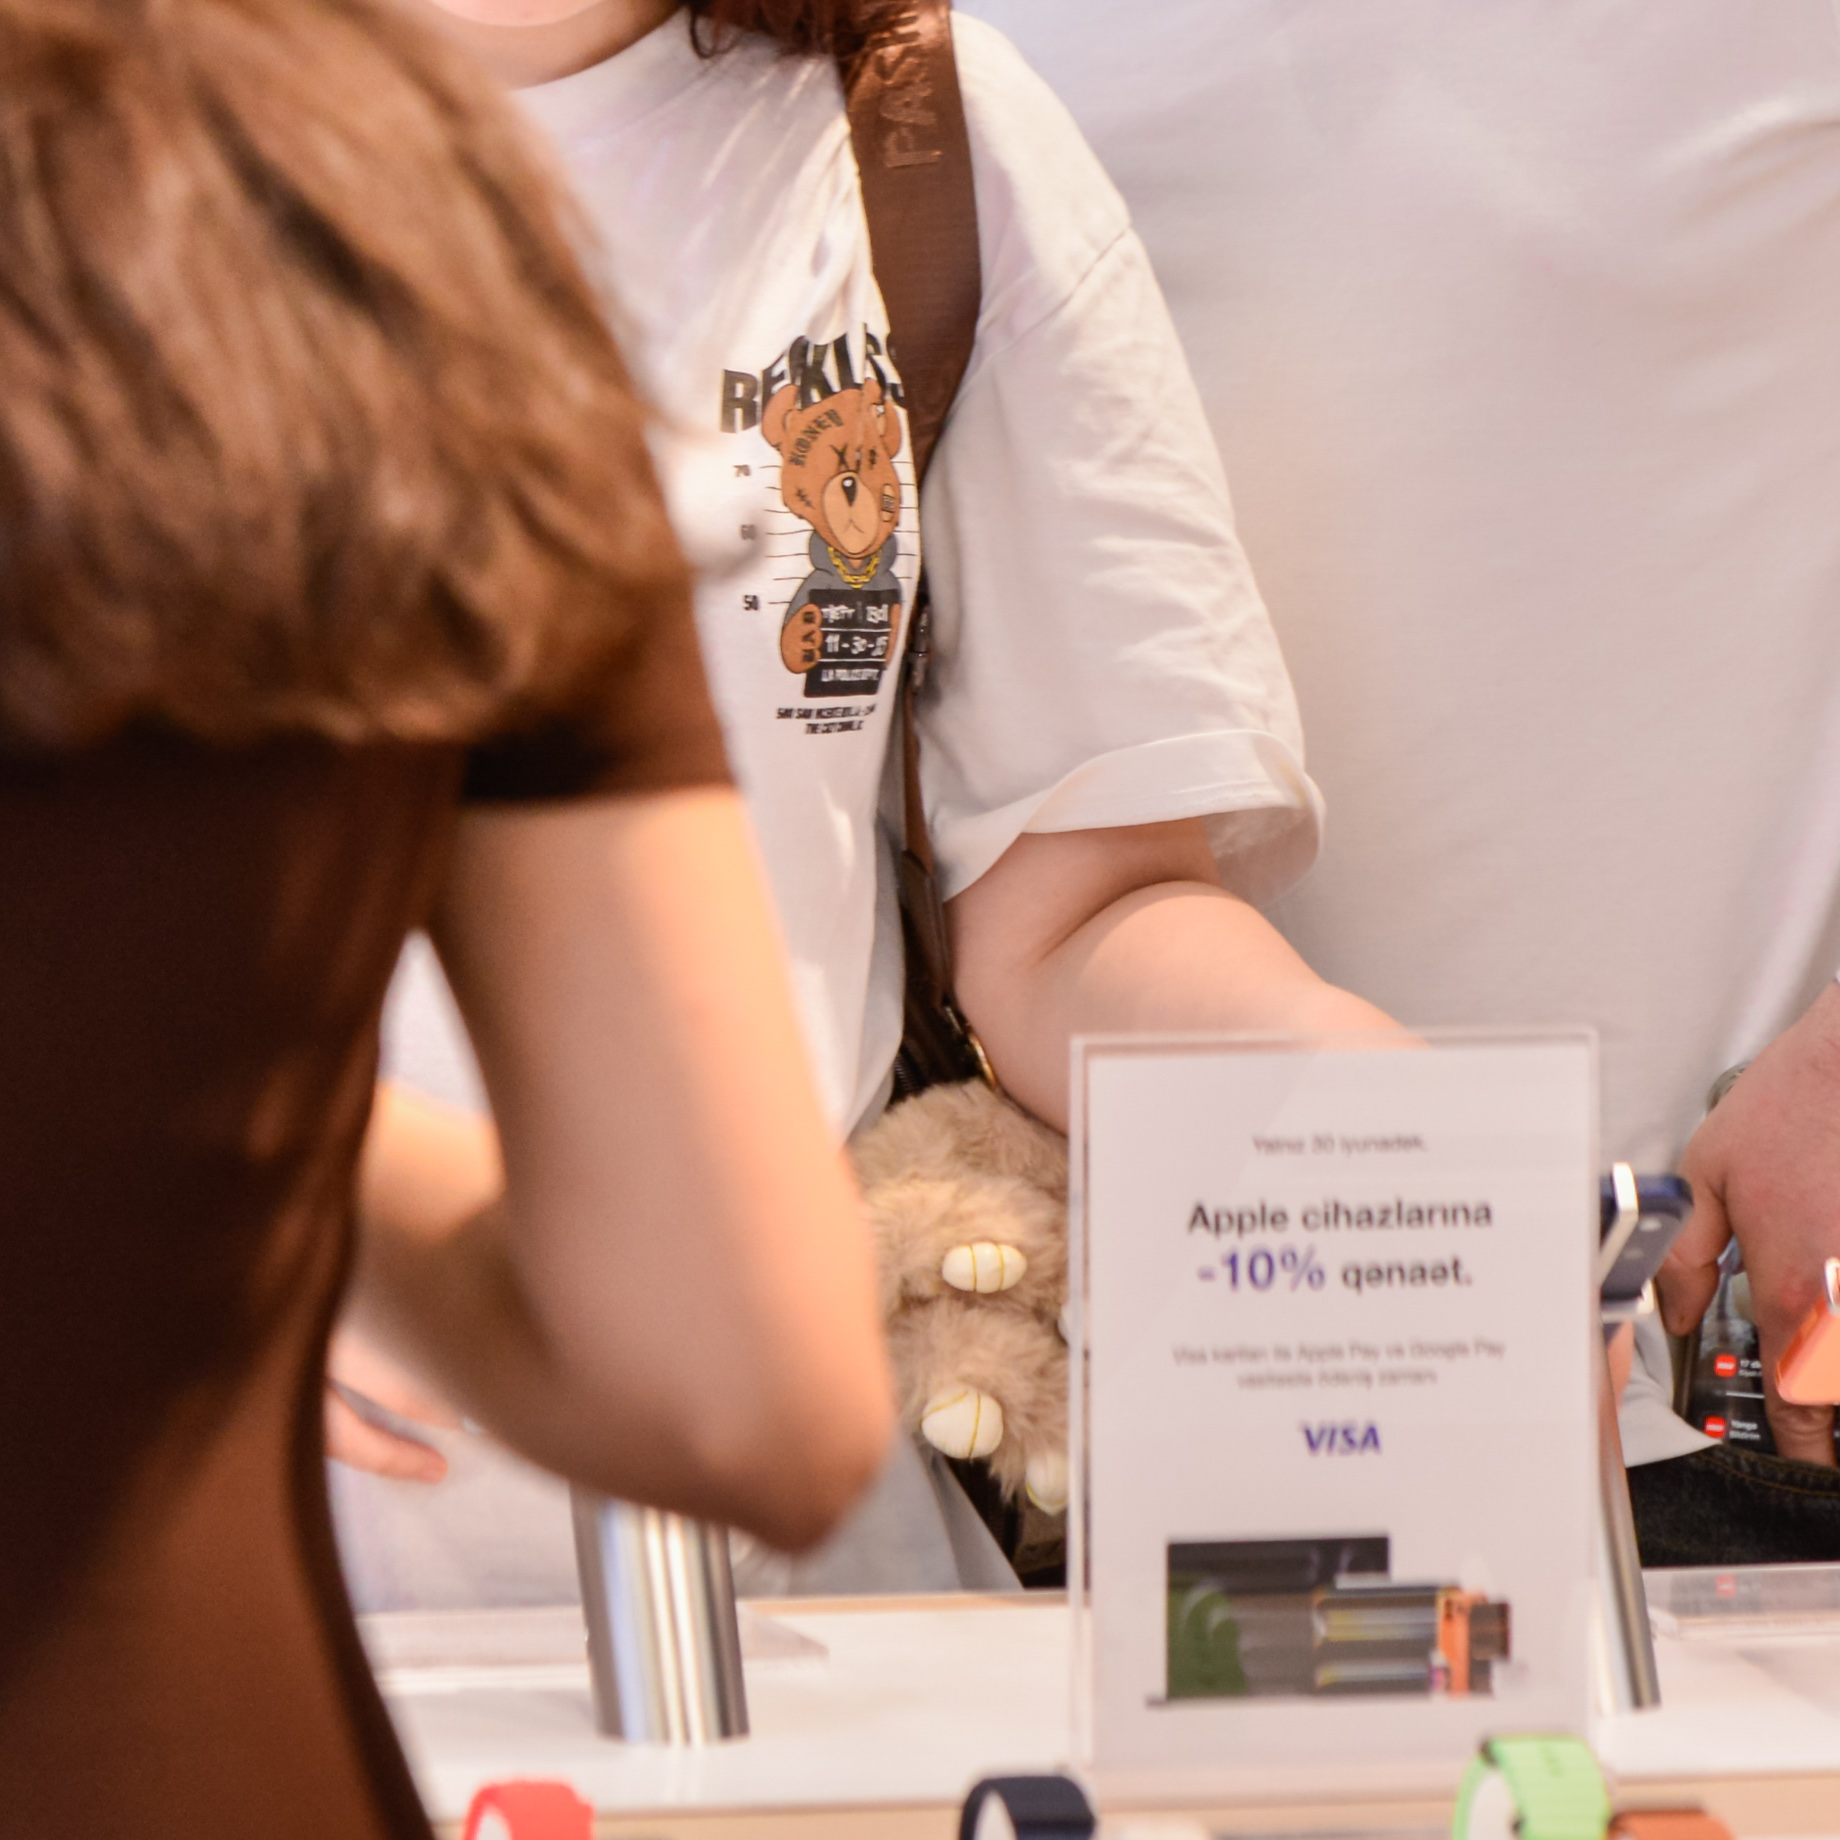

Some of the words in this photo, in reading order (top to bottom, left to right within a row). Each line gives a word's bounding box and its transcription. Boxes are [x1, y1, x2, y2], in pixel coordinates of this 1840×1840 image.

[1187, 1200, 1289, 1238] Apple
[1301, 1196, 1493, 1231] cihazlarına
[1198, 1244, 1326, 1292] -10%
[1304, 1421, 1382, 1456] VISA
